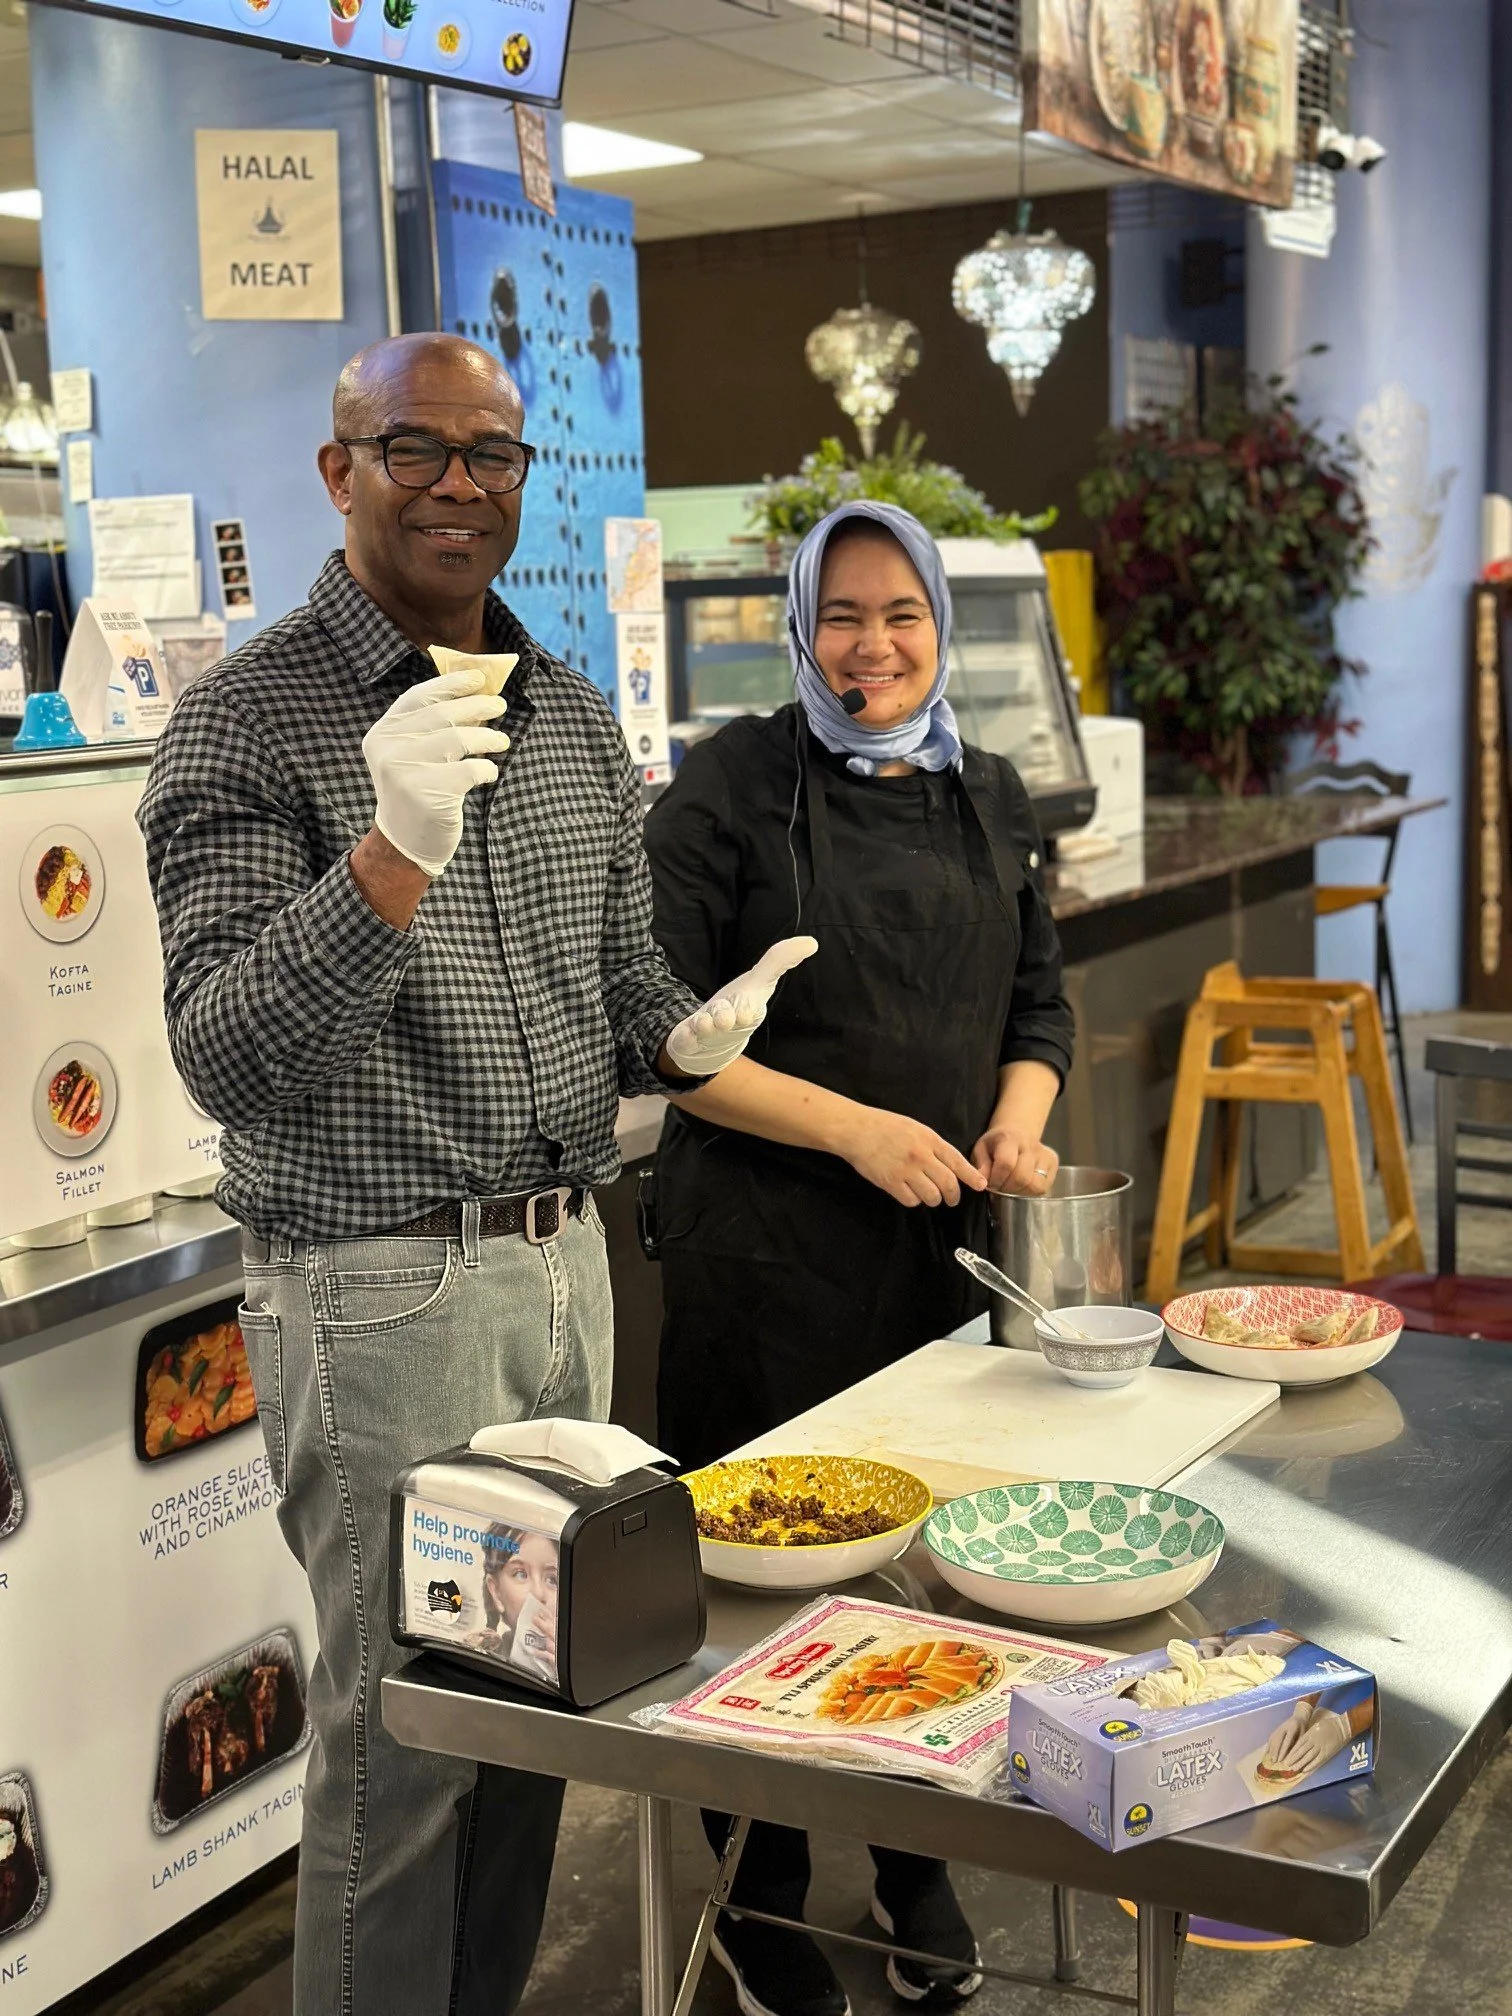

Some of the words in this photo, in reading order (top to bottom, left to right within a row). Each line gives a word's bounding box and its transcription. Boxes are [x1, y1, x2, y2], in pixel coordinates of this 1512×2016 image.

[223, 156, 314, 180] HALAL
[231, 263, 312, 286] MEAT
[50, 964, 89, 980] KOFTA
[48, 981, 92, 997] TAGINE
[188, 1134, 217, 1150] LAMB
[56, 1163, 105, 1185] SALMON
[63, 1181, 101, 1201] FILLET
[139, 1513, 181, 1546] WITH
[188, 1490, 233, 1524] ROSE
[237, 1472, 272, 1500] WAT
[151, 1475, 222, 1520] ORANGE
[154, 1529, 190, 1560] AND
[196, 1487, 284, 1539] CINAMMON
[413, 1510, 448, 1538] Help
[453, 1523, 521, 1555] promote
[412, 1533, 474, 1566] hygiene
[797, 1669, 831, 1690] SPRING
[825, 1653, 851, 1669] ROLL
[846, 1635, 879, 1654] PASTRY
[1316, 1660, 1352, 1674] XL
[1047, 1667, 1135, 1697] LATEX
[1038, 1718, 1079, 1748] SmoothTouch
[1032, 1729, 1082, 1780] LATEX
[1162, 1737, 1213, 1759] SmoothTouch
[1350, 1742, 1368, 1763] XL
[1041, 1756, 1069, 1780] GLOVES
[1157, 1749, 1222, 1788] LATEX
[1170, 1775, 1207, 1792] GLOVES
[152, 1849, 198, 1890] LAMB
[202, 1810, 259, 1857] SHANK
